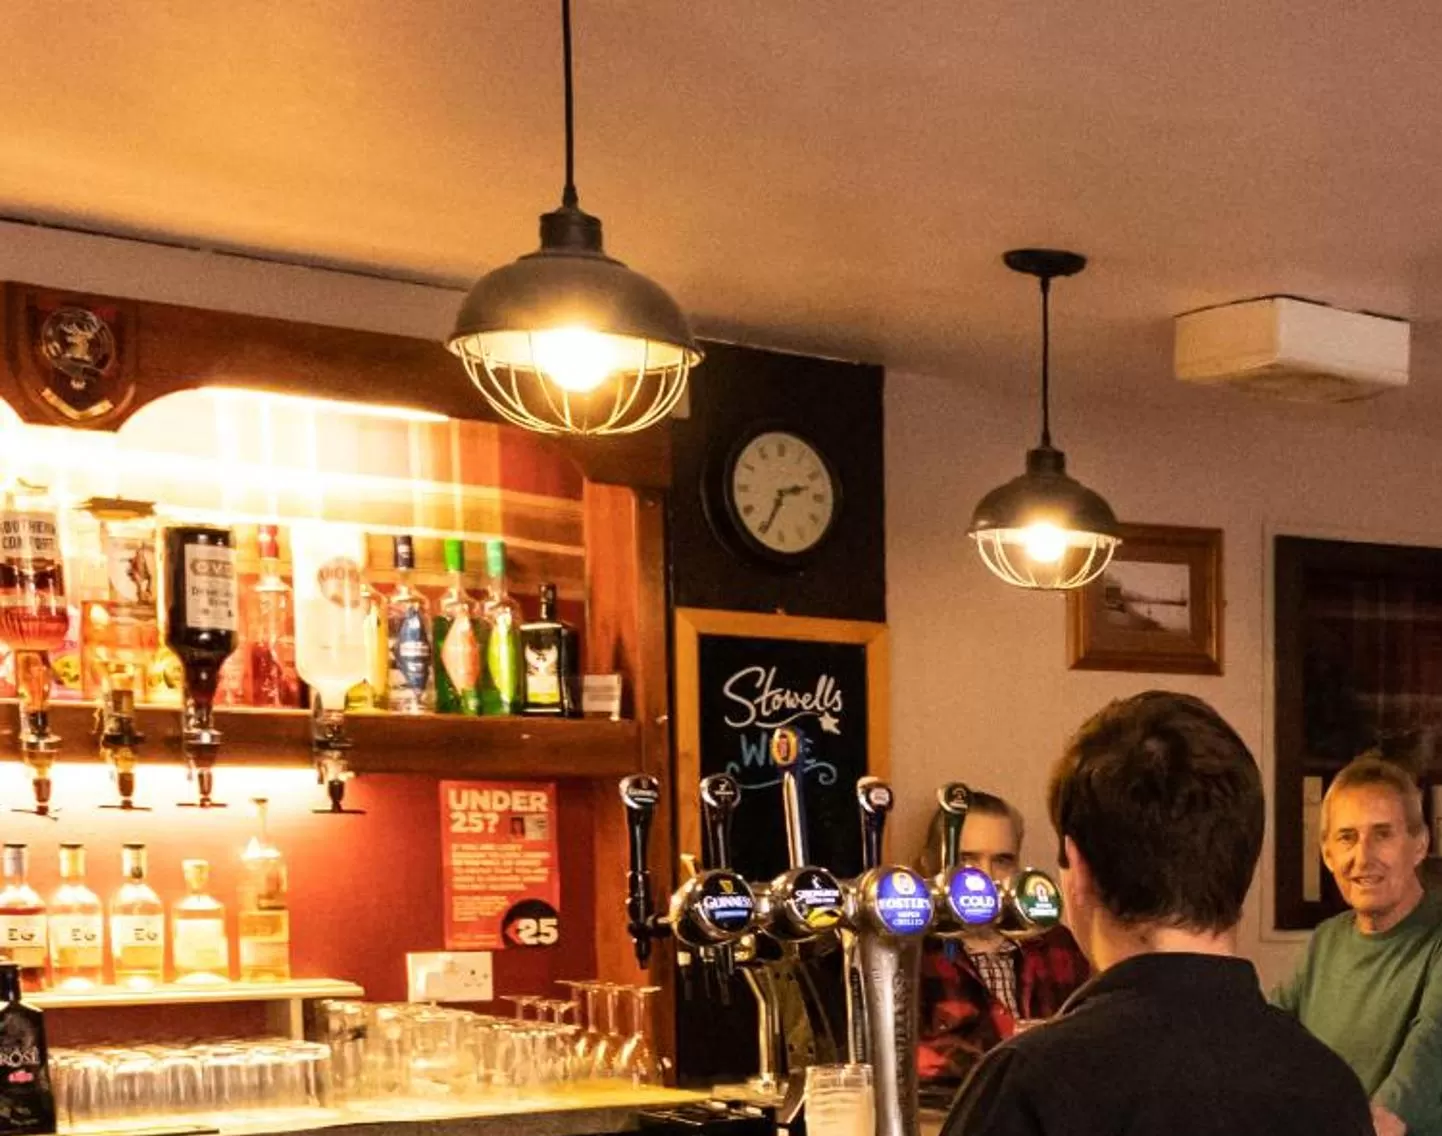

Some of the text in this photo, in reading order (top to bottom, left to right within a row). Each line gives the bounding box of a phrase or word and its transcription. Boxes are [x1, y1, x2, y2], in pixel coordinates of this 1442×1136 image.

[723, 666, 843, 728] Stowells
[448, 789, 549, 812] UNDER
[450, 811, 499, 833] 25?
[703, 895, 753, 910] GUINNESS
[518, 918, 559, 945] 25
